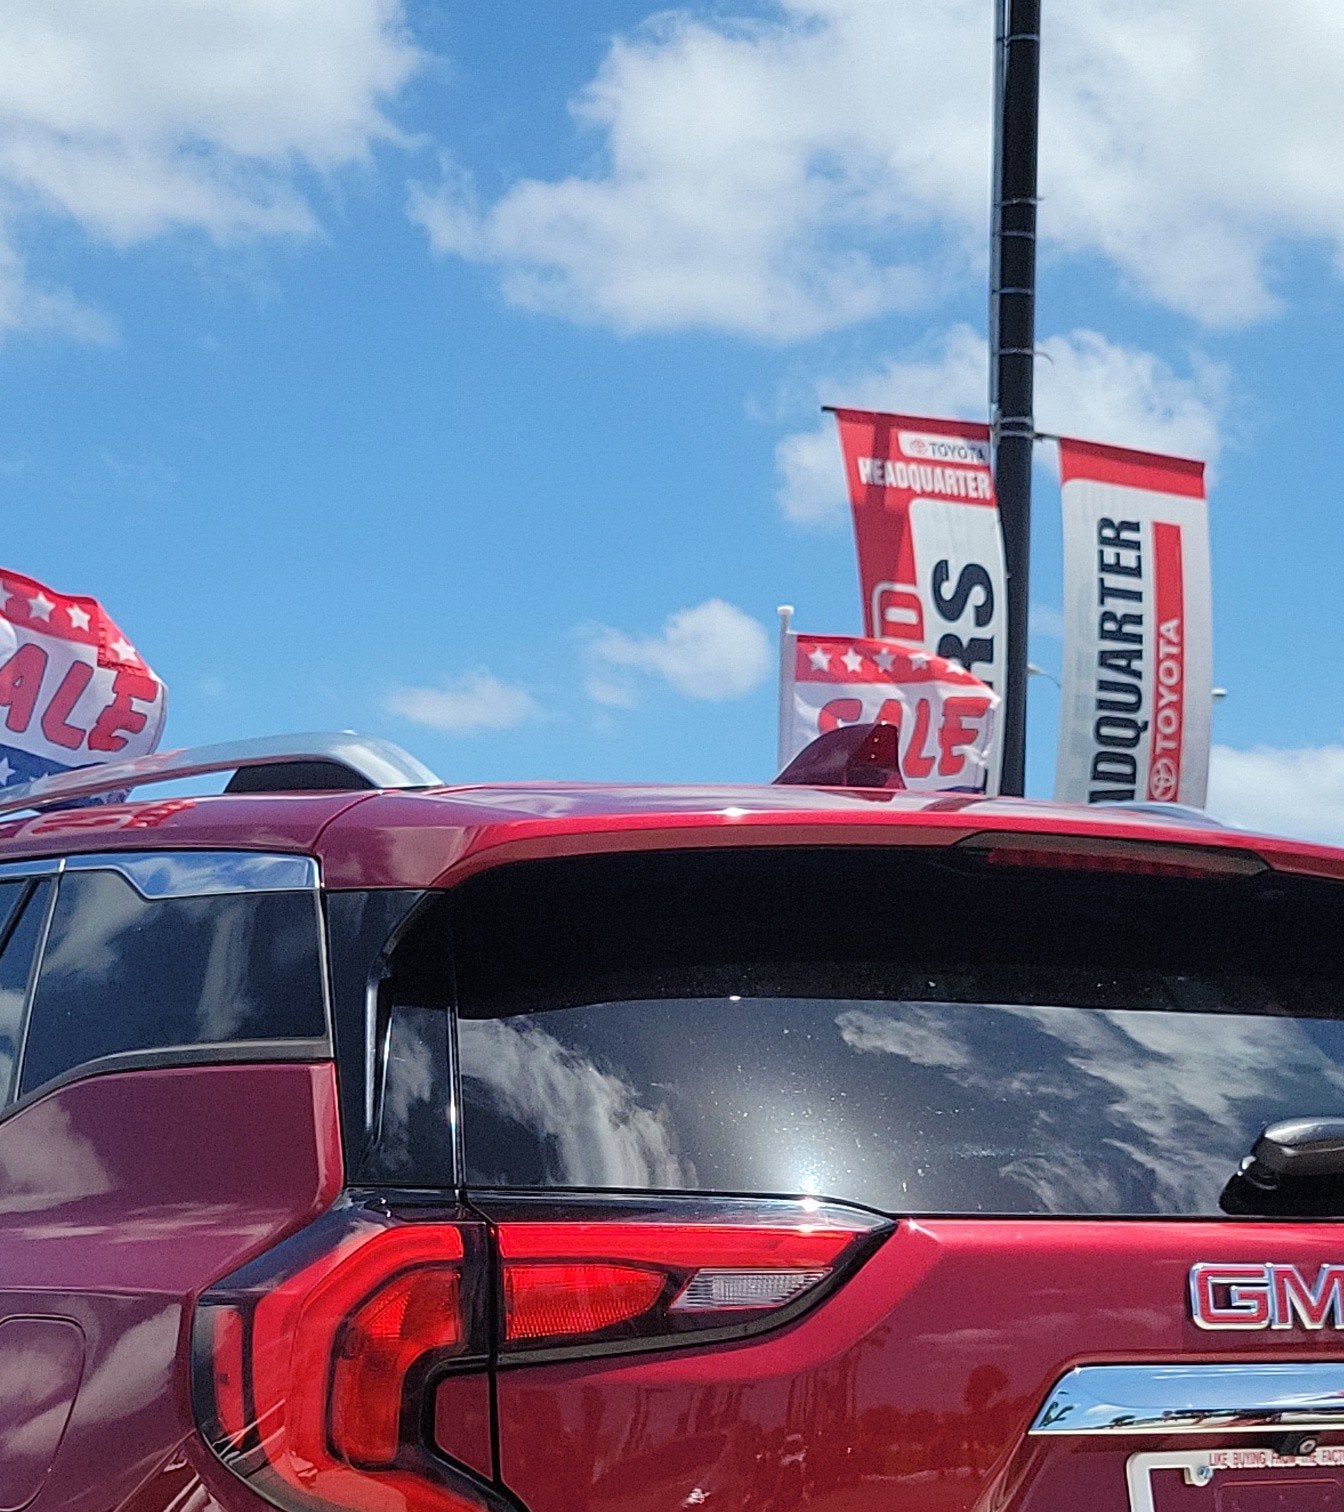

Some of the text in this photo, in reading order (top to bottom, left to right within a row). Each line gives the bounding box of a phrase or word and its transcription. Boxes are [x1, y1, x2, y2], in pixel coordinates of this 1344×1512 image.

[928, 442, 986, 462] TOYOTA
[858, 457, 992, 500] HEADQUARTER
[1088, 517, 1149, 803] DQUARTER
[1155, 617, 1183, 756] TOYOTA
[1233, 1451, 1266, 1466] BUYING
